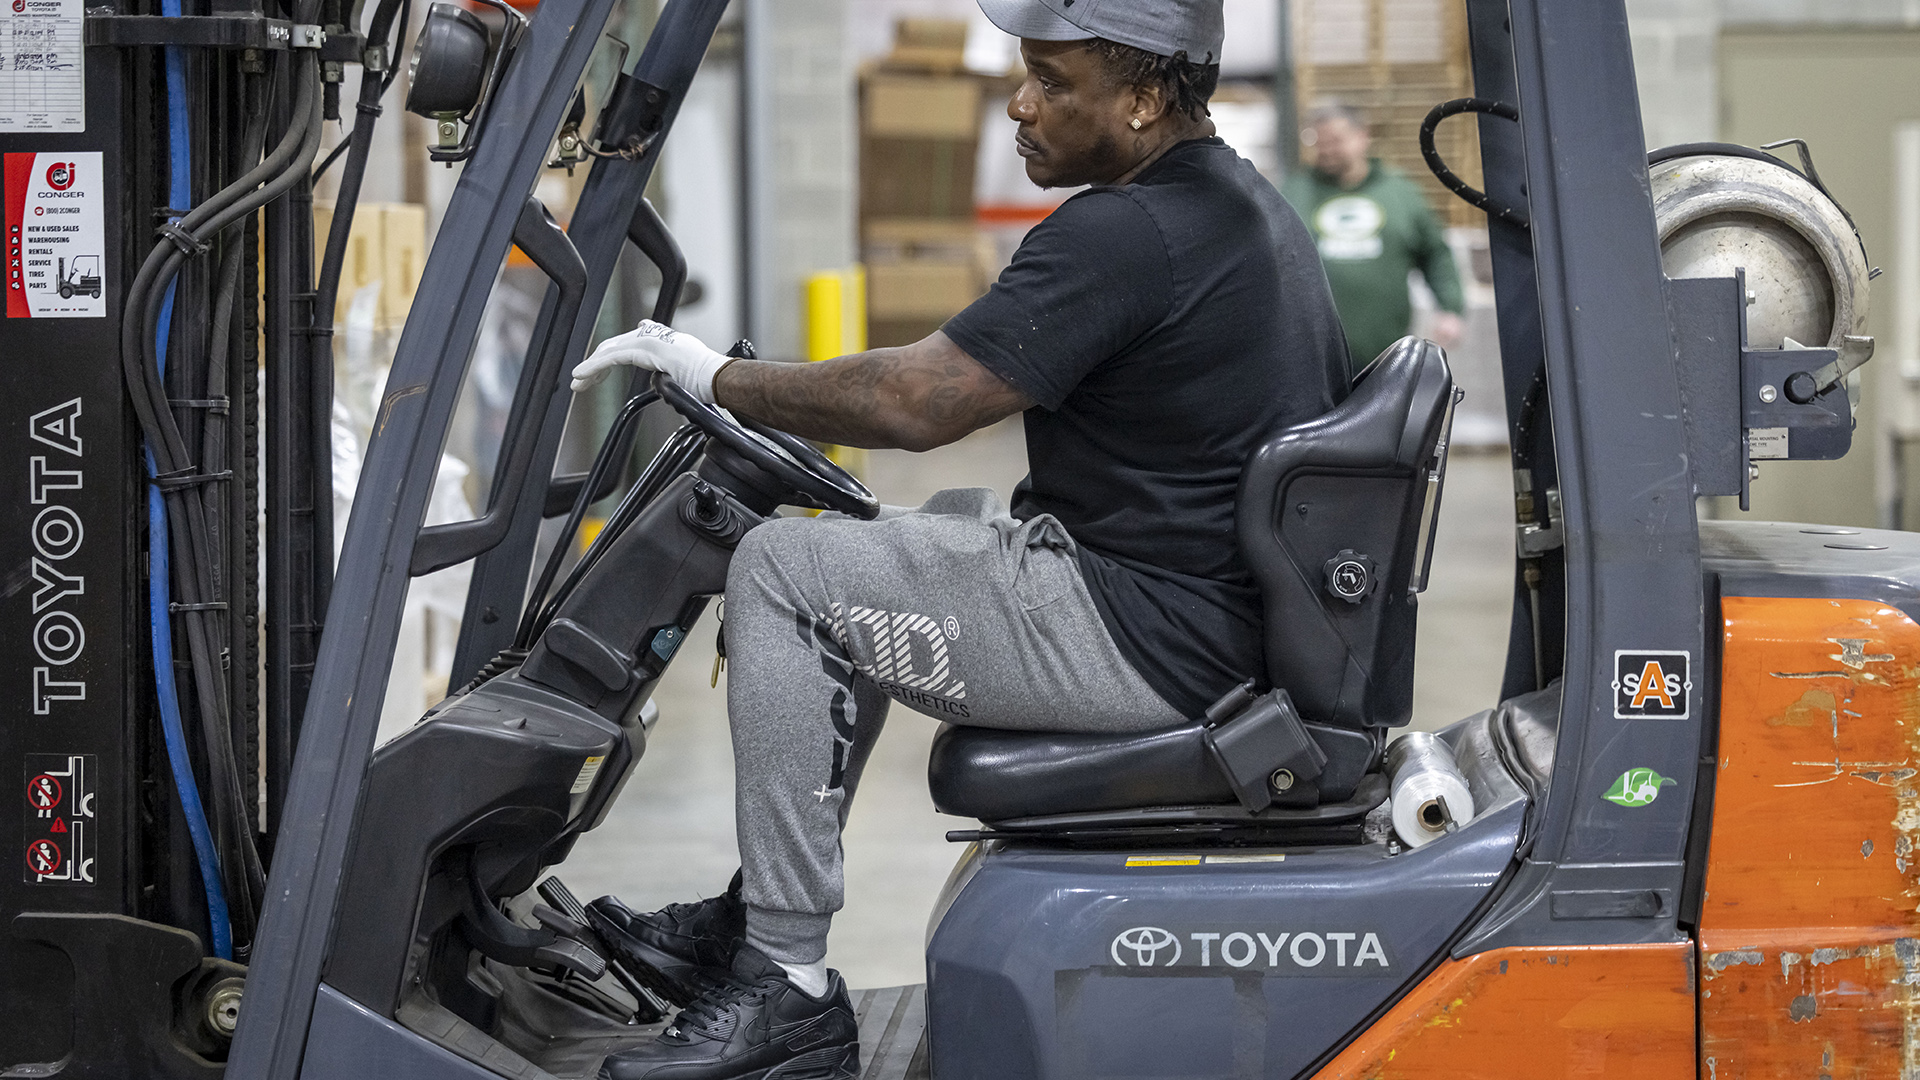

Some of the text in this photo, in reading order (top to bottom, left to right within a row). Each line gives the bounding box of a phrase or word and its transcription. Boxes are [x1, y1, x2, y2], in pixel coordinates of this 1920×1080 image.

[30, 397, 86, 715] TOYOTA
[872, 680, 970, 718] ESTHETICS
[1622, 661, 1682, 709] SAS
[1191, 931, 1390, 968] TOYOTA
